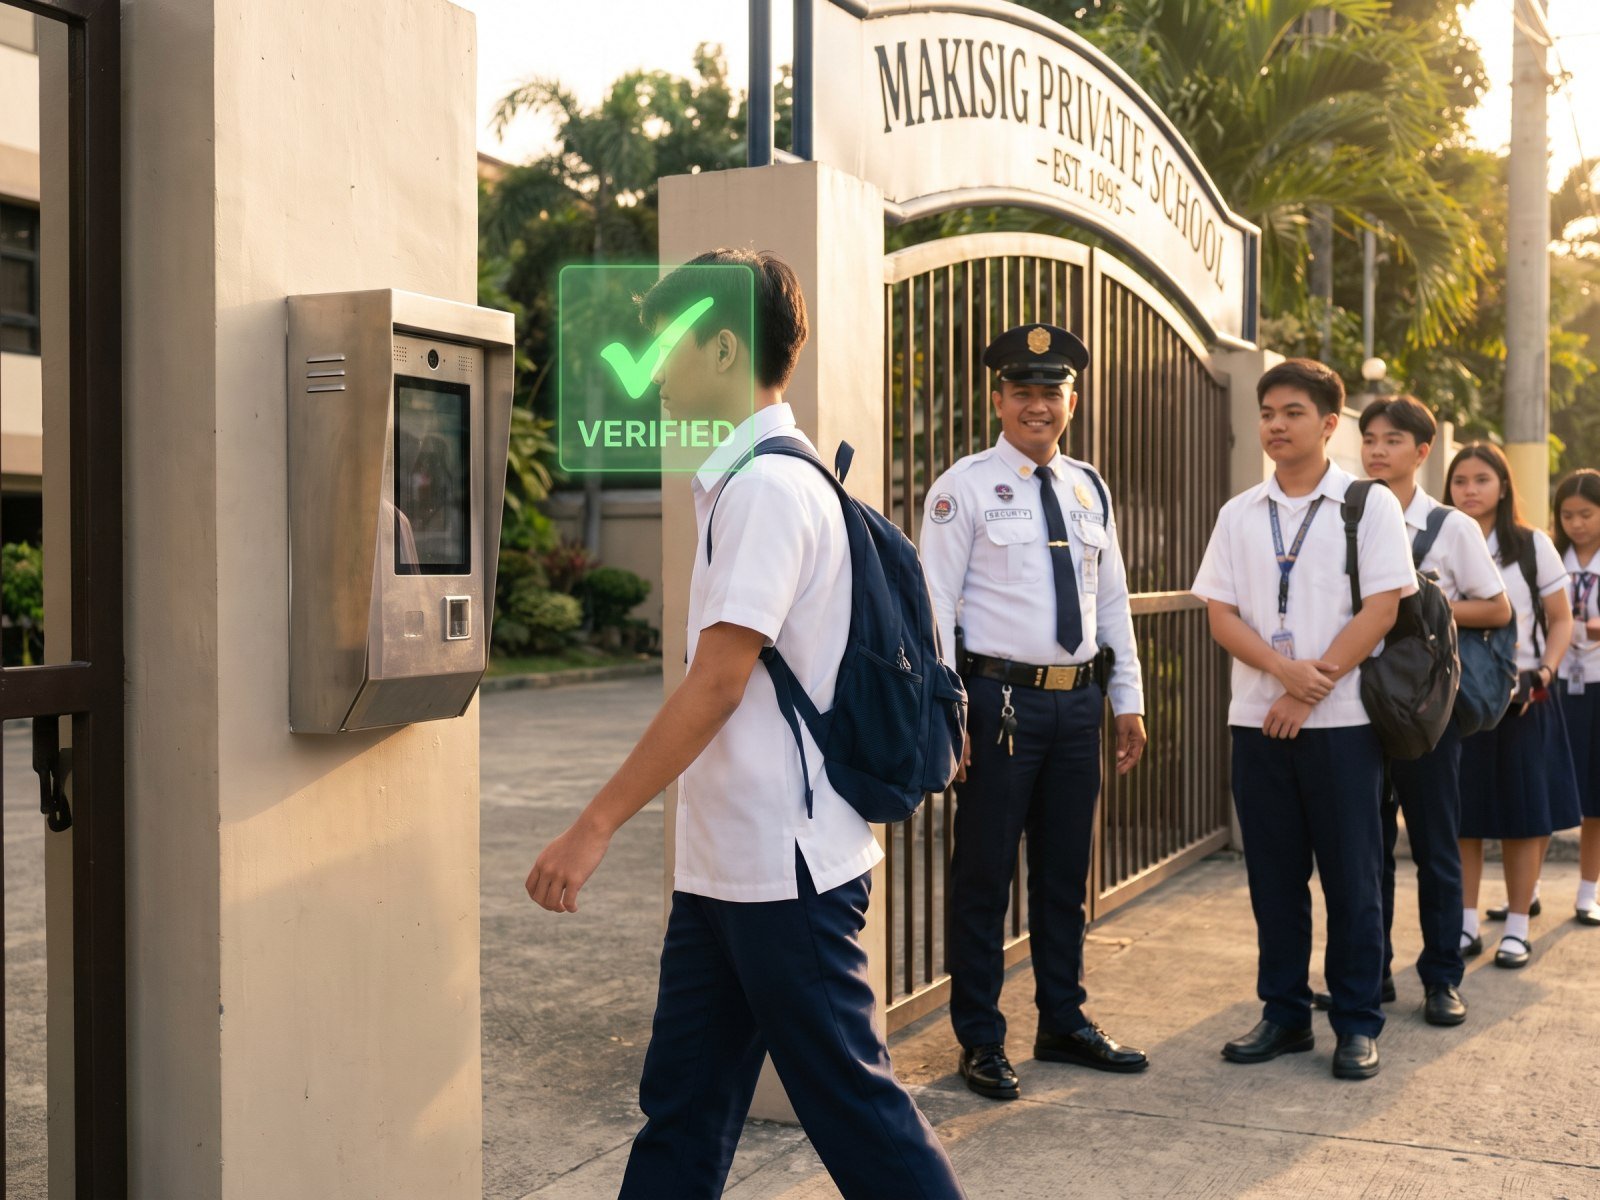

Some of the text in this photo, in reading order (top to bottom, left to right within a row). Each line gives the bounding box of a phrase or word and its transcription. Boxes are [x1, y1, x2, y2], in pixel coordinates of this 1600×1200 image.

[875, 38, 1225, 292] MAKISIG PRIVATE SCHOOL
